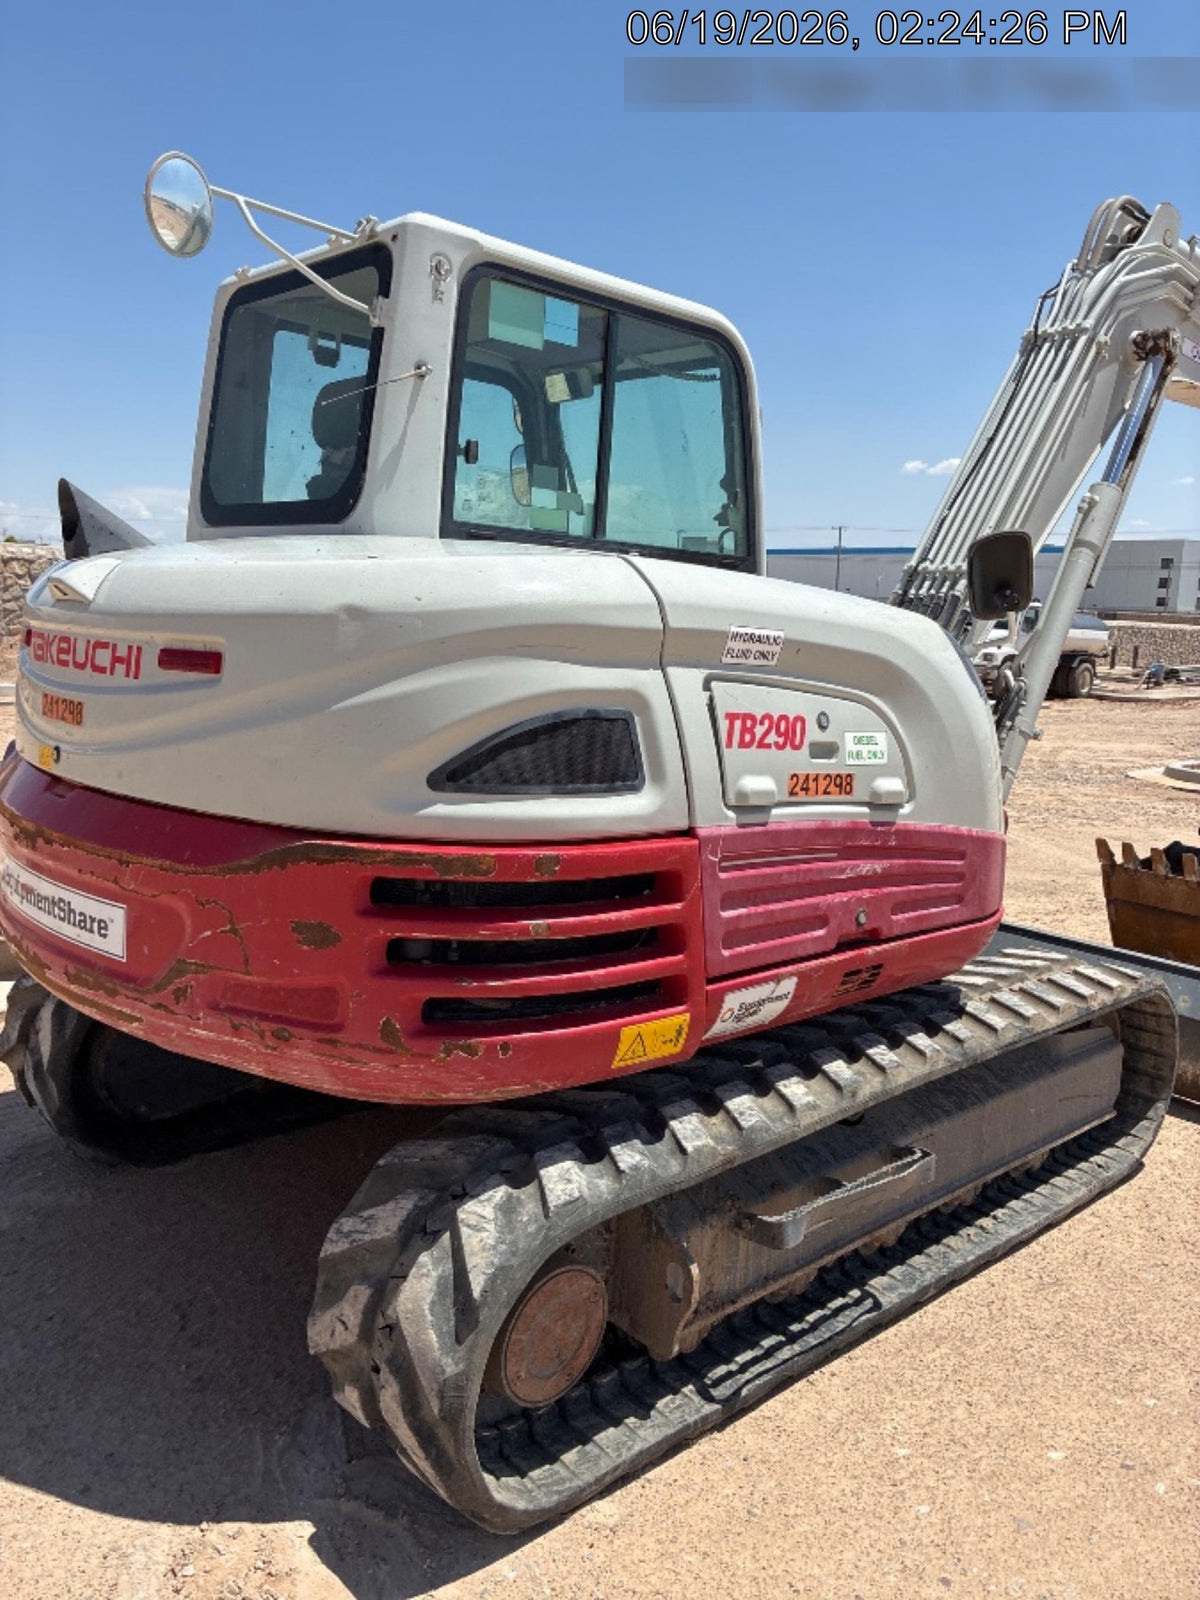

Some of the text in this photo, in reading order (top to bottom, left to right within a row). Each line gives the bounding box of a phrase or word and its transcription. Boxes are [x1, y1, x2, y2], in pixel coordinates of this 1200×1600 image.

[42, 692, 83, 726] 241298
[724, 712, 806, 751] TB290
[788, 773, 853, 796] 241298
